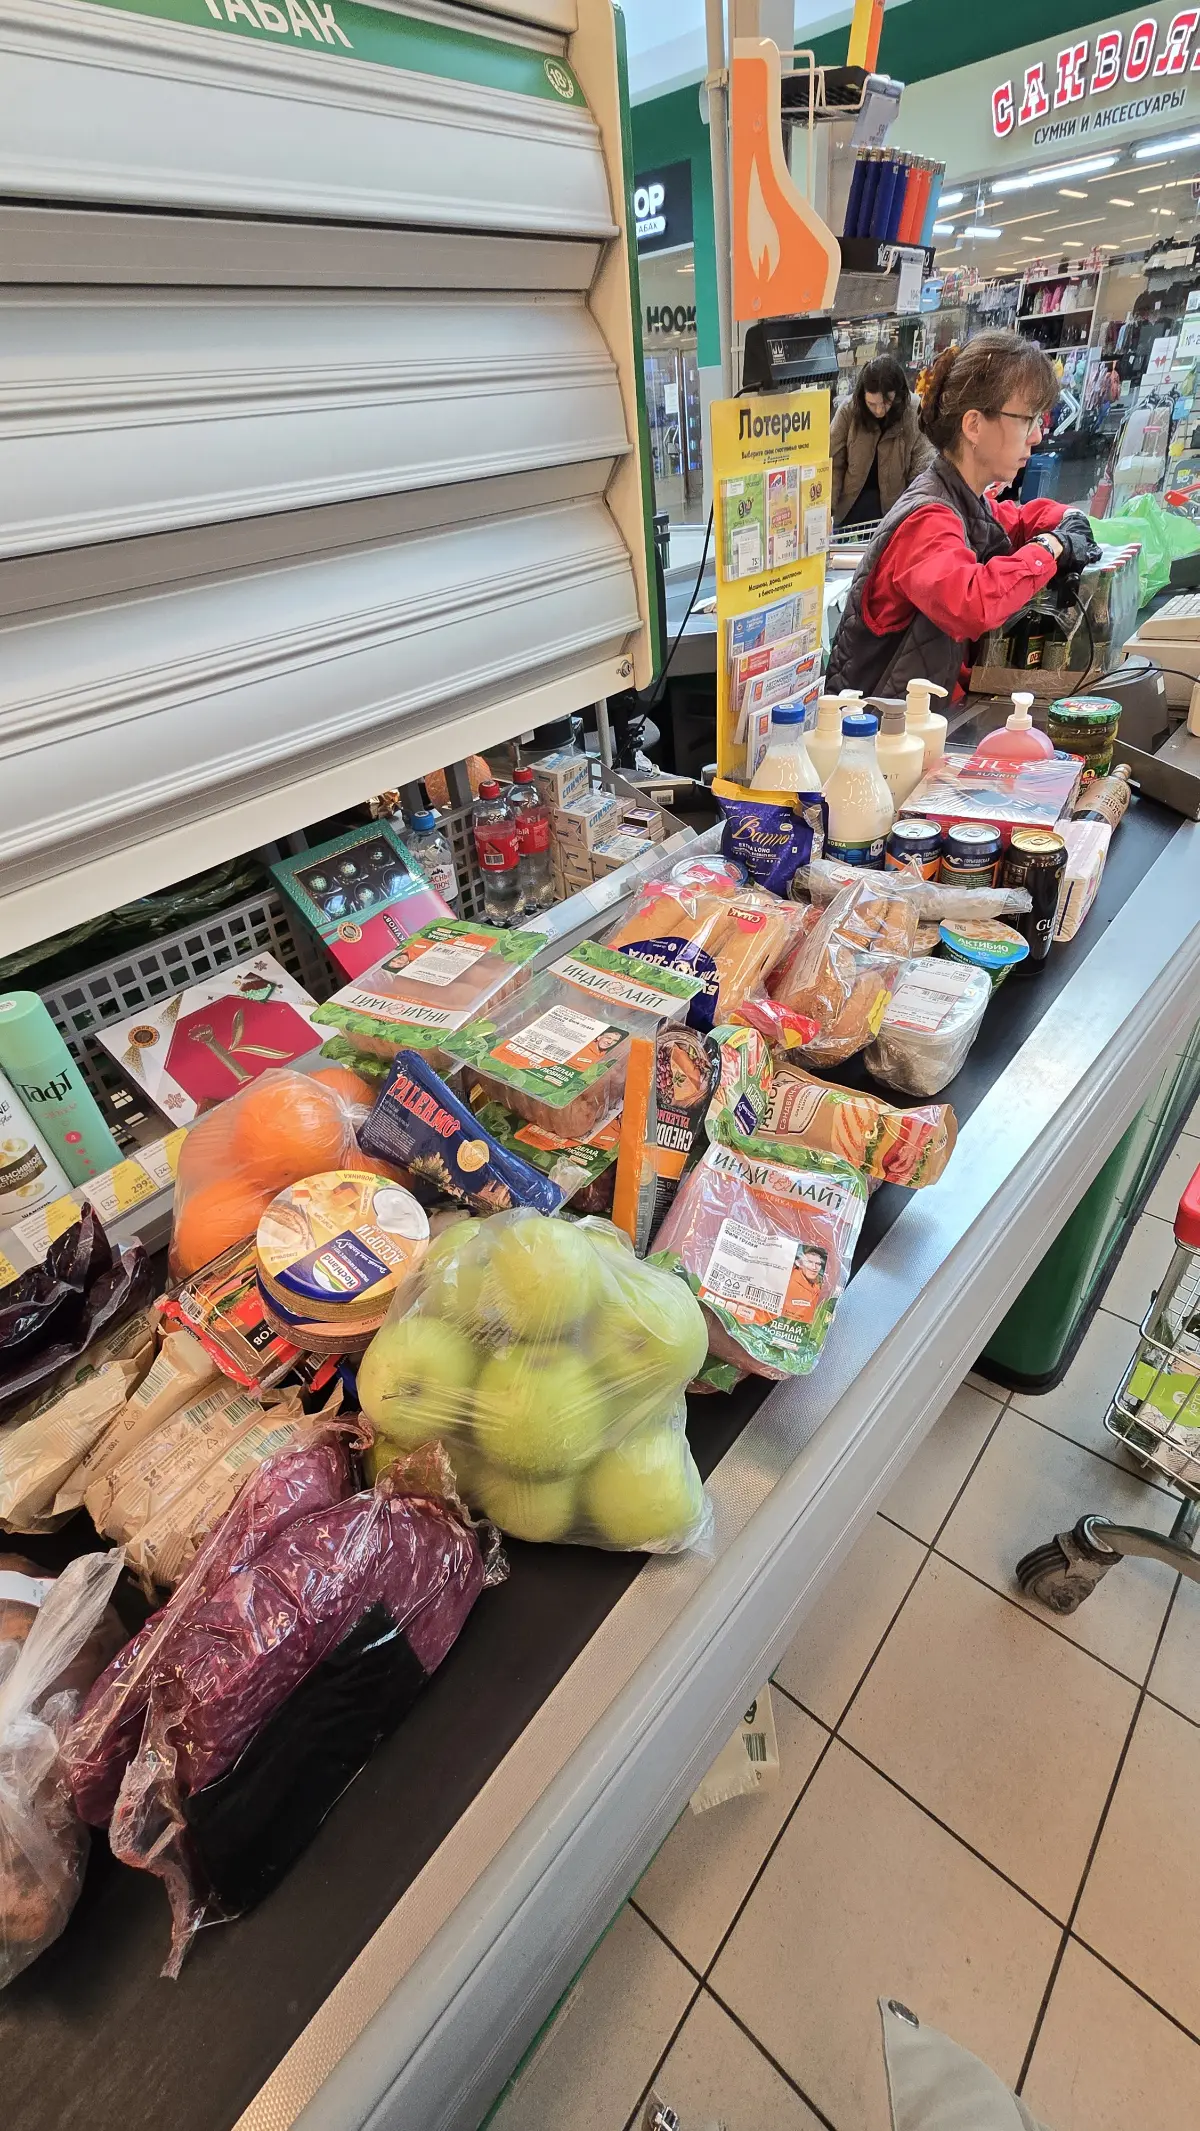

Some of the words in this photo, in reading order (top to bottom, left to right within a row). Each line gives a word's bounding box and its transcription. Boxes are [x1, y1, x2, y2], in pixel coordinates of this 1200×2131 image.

[991, 8, 1200, 138] САКВОЯ
[1034, 121, 1076, 145] СУМКИ
[1080, 117, 1091, 133] И
[1093, 89, 1186, 131] АКСЕССУАРЫ
[738, 408, 811, 443] Лотереи
[562, 764, 588, 799] СПИЧКИ
[754, 846, 771, 854] LONG
[348, 993, 393, 1011] ЛАЙТ
[562, 964, 608, 991] ИНДИ
[620, 988, 669, 1008] ЛАЙТ
[405, 1005, 450, 1023] ИНДИ
[387, 1077, 461, 1138] PALERMO
[656, 1122, 693, 1151] CHEDD
[343, 1172, 375, 1183] НОВИНКА
[355, 1223, 403, 1266] АССОРТИ
[322, 1253, 358, 1288] Hochland
[770, 1320, 805, 1337] ДЕЛАЙ,
